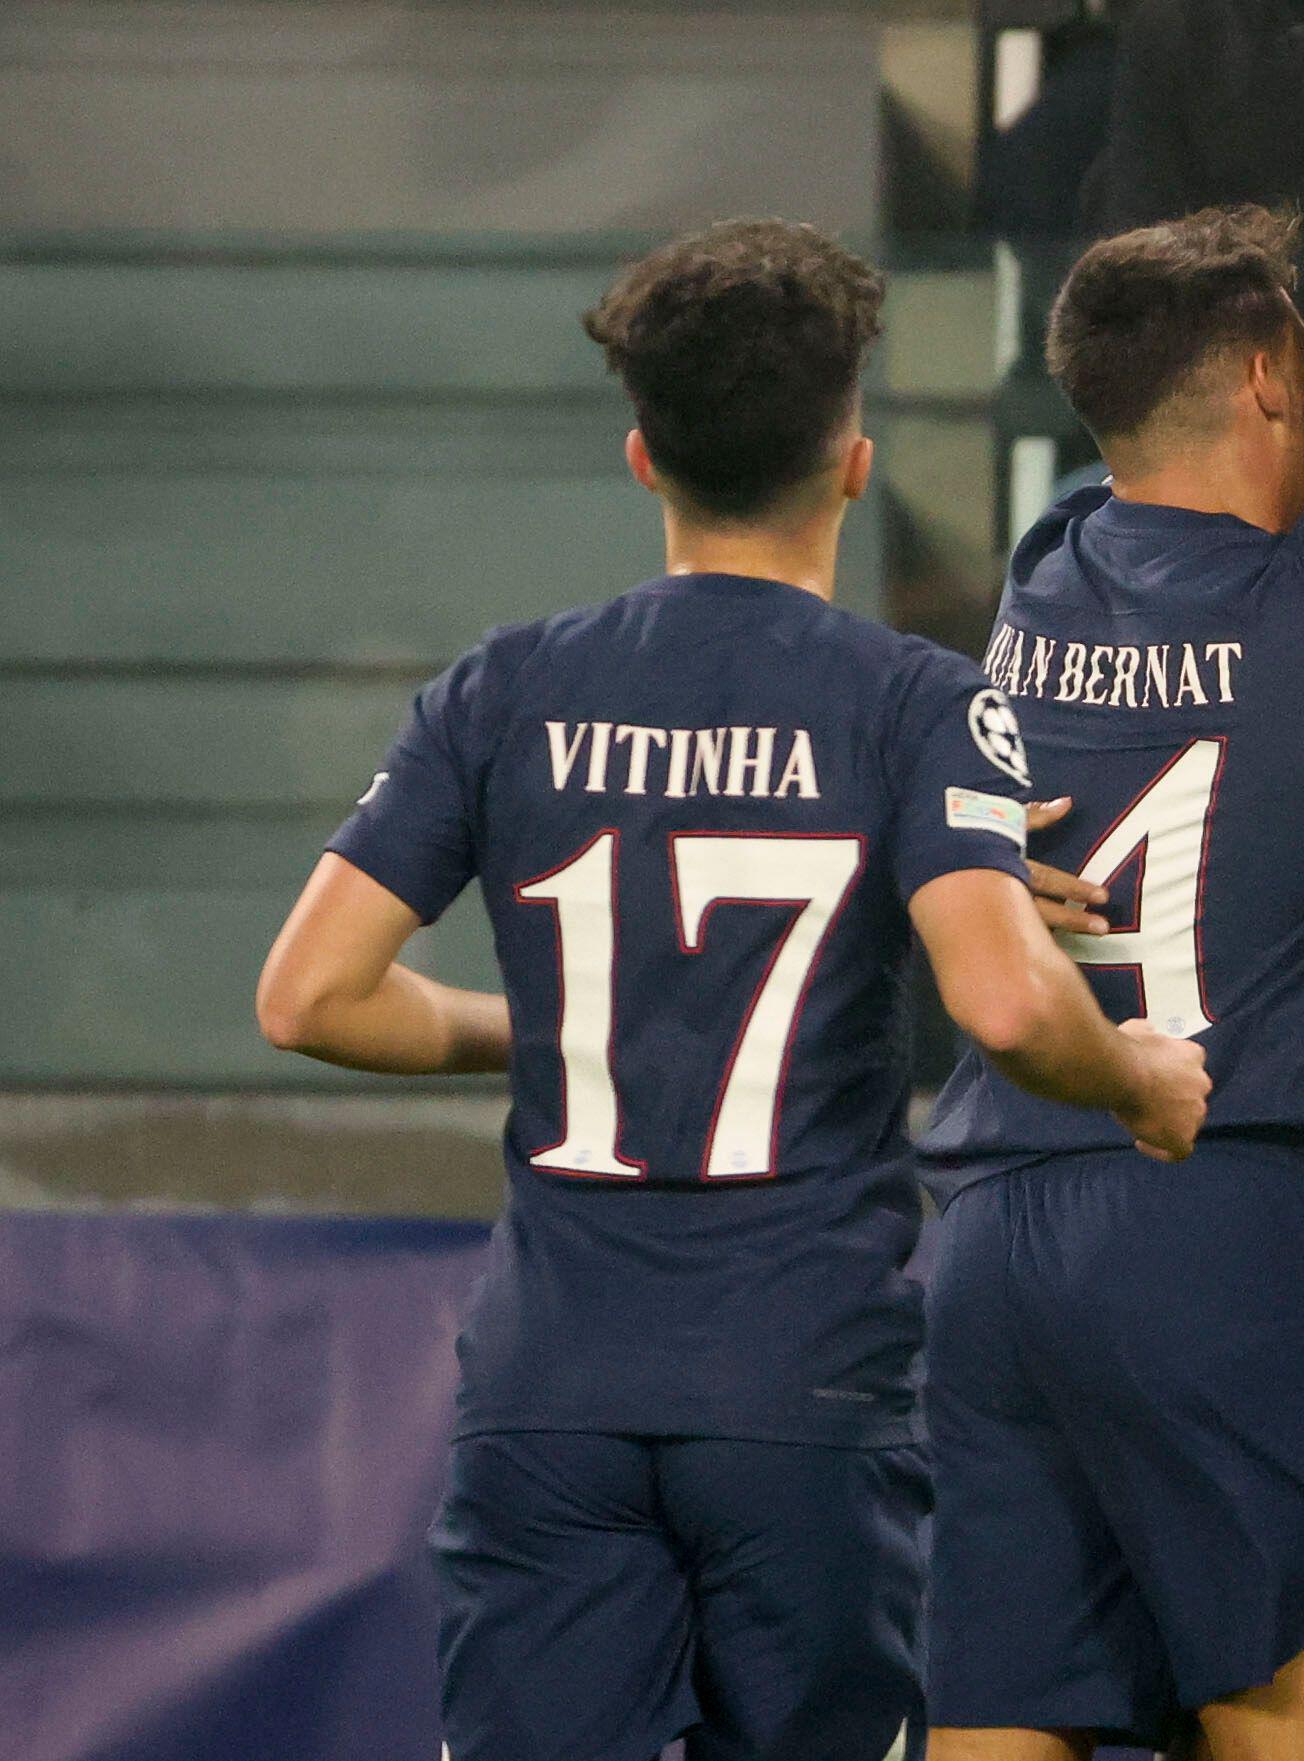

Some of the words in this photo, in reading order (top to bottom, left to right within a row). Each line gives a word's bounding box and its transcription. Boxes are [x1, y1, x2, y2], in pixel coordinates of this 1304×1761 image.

[1053, 642, 1242, 708] BERNAT
[545, 721, 821, 799] VITINHA
[514, 829, 868, 1181] 17
